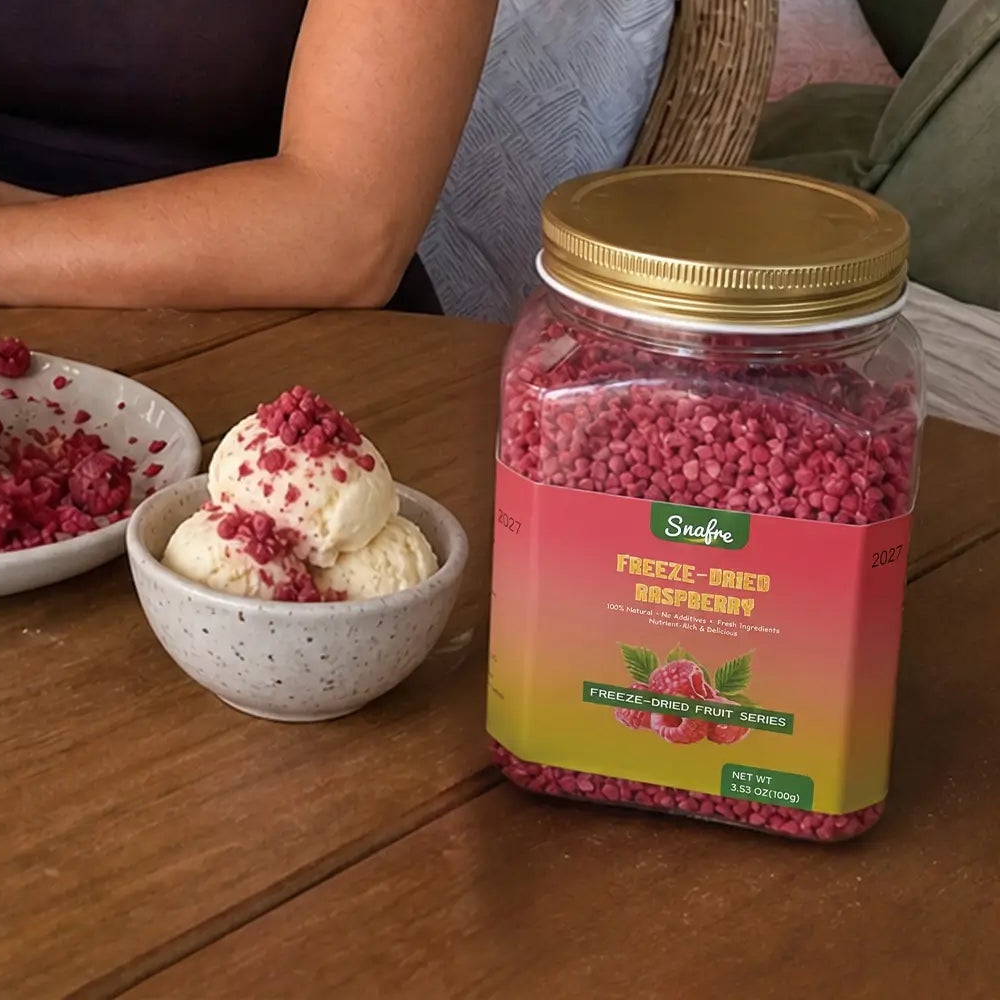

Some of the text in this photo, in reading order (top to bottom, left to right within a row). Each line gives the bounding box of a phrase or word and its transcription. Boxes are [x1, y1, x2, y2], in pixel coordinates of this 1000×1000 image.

[498, 508, 521, 535] 2027
[664, 515, 734, 545] Snafre
[872, 544, 903, 568] 2027
[616, 553, 771, 593] FREEZE-DRIED
[635, 583, 755, 617] RASPBERRY
[607, 602, 624, 612] 100%
[626, 606, 653, 616] Natural
[673, 613, 707, 624] Additives
[717, 619, 737, 628] Fresh
[739, 622, 780, 634] Ingredients
[706, 626, 738, 637] Delicious
[590, 687, 787, 727] FREEZE-DRIED FRUIT SERIES
[732, 771, 773, 785] NET WT
[730, 783, 800, 804] 3.53 OZ(100g)
